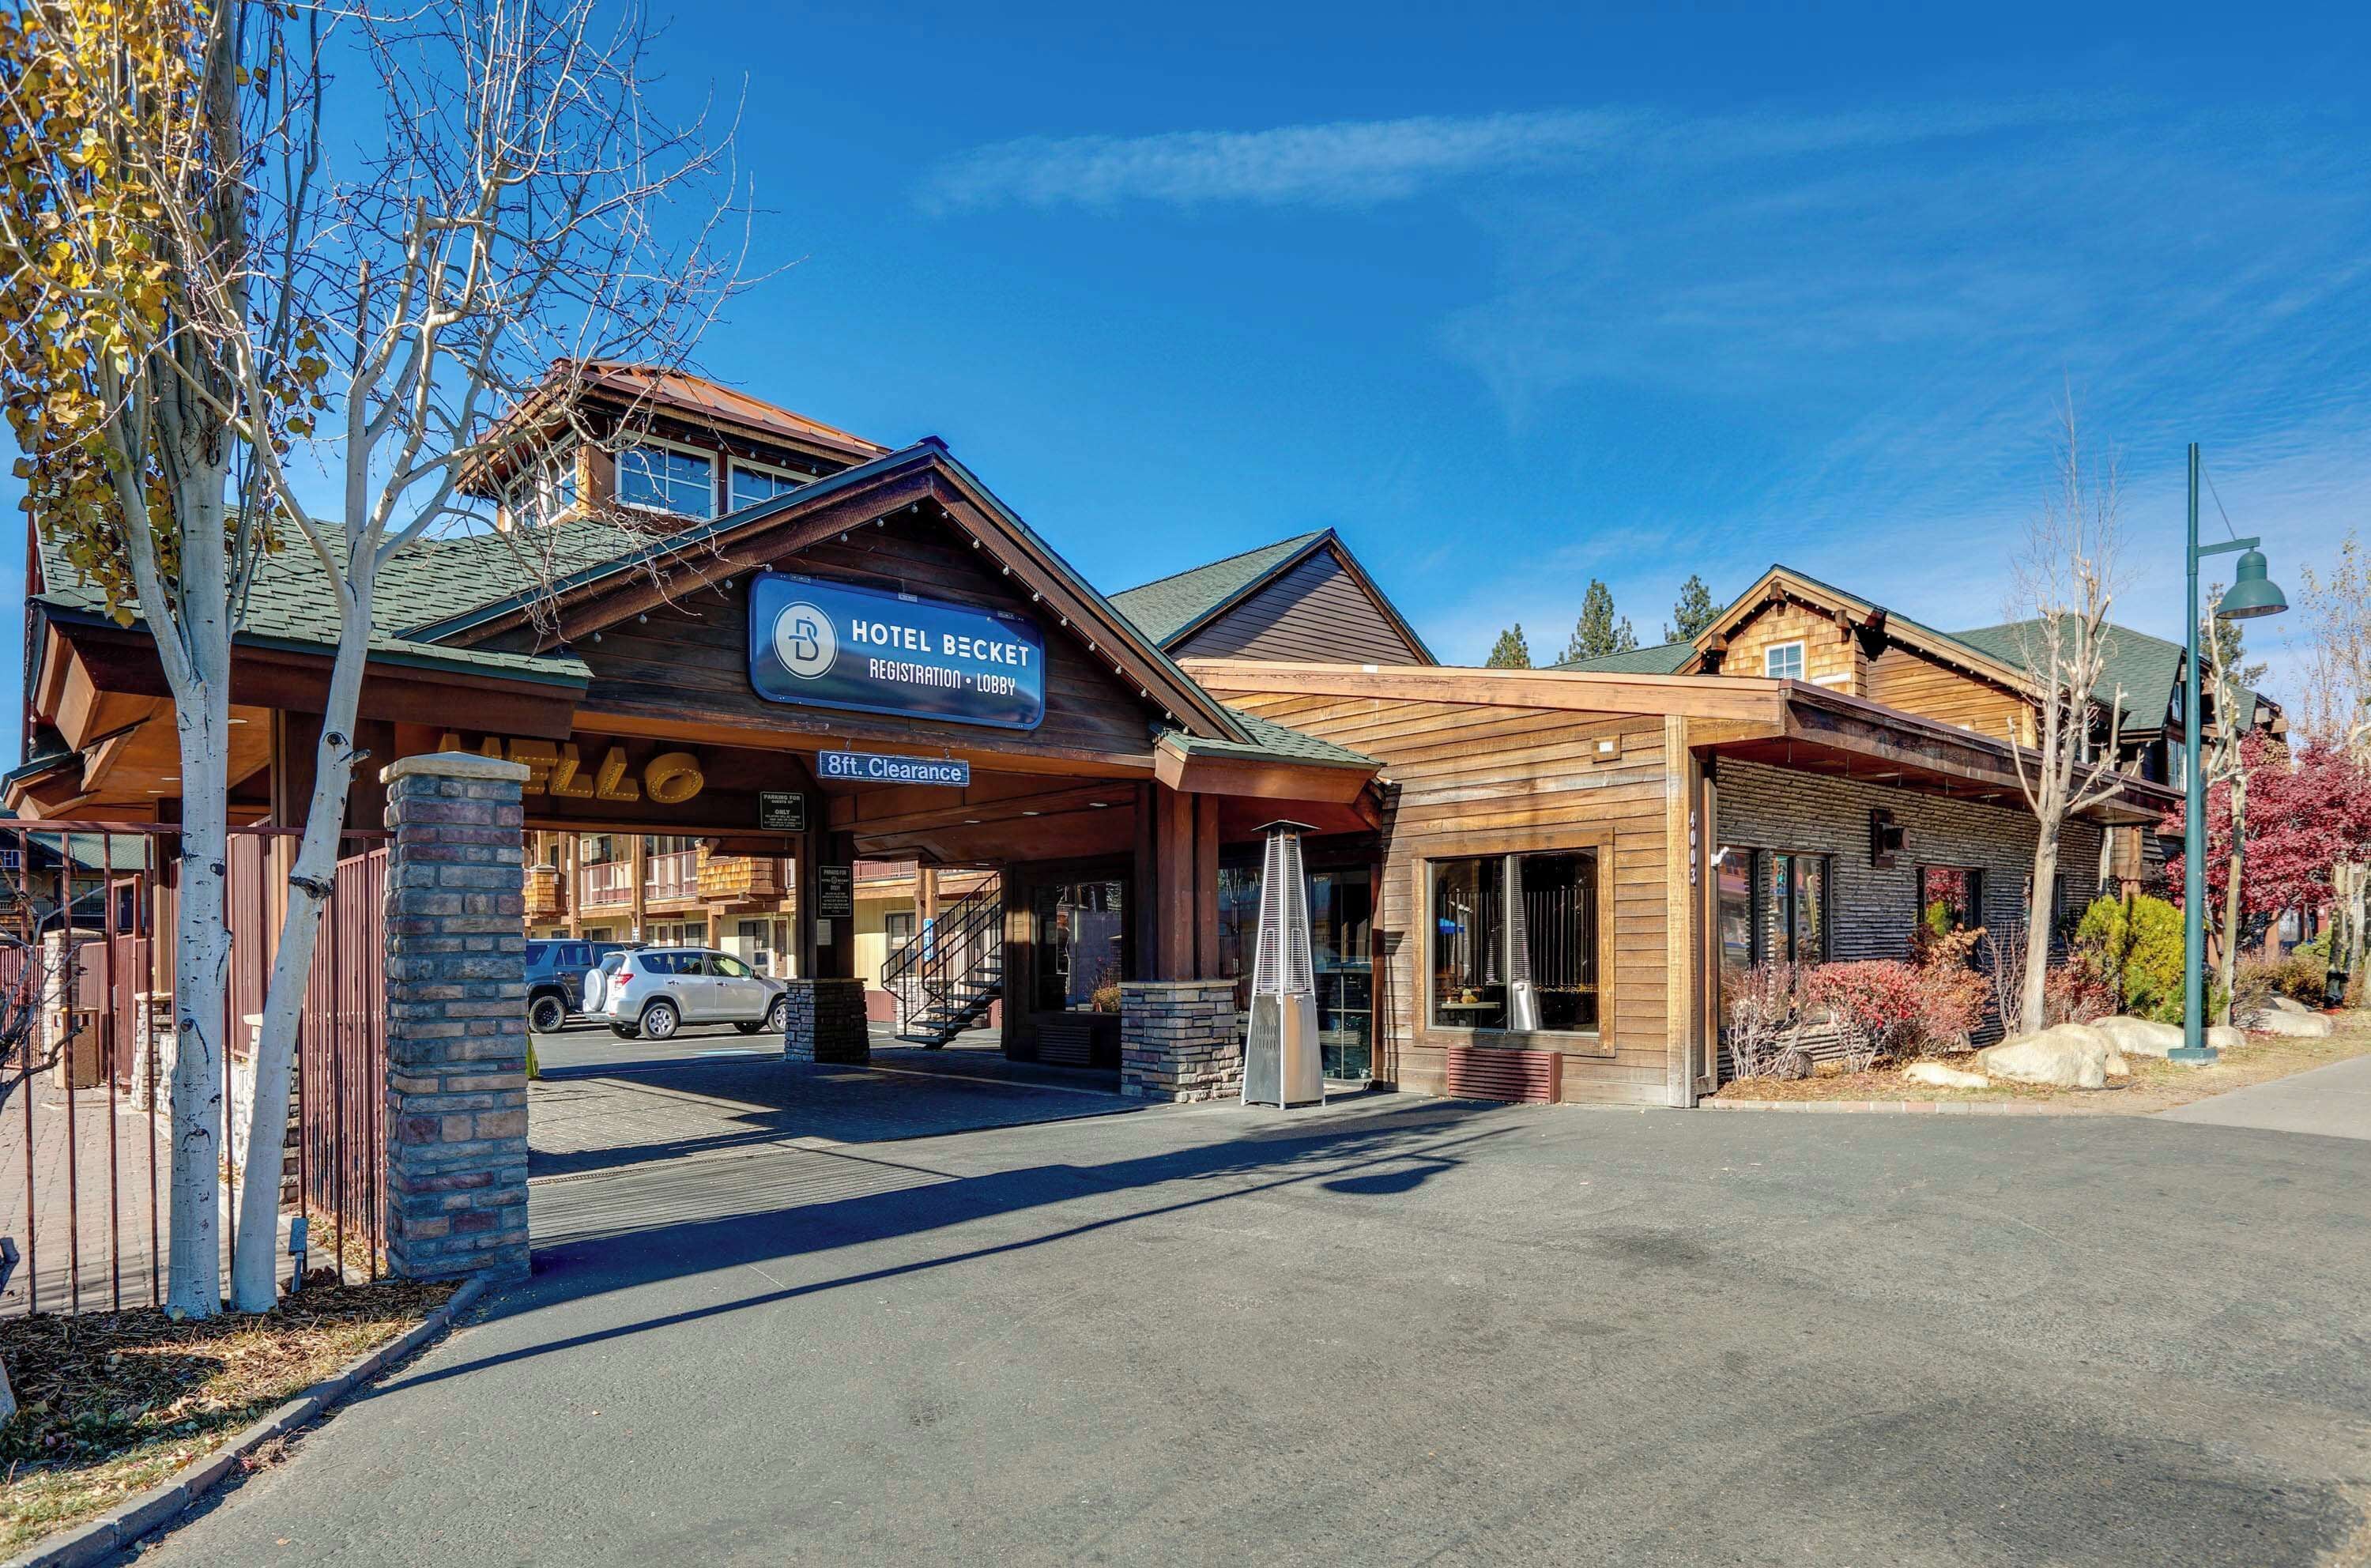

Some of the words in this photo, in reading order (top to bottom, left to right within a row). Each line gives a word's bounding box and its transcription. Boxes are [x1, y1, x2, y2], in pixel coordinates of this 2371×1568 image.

[852, 619, 931, 652] HOTEL
[943, 634, 1028, 666] BECKET
[869, 658, 961, 689] REGISTRATION
[977, 673, 1016, 696] LOBBY
[437, 733, 704, 804] ELLO
[828, 755, 862, 776] 8ft.
[869, 757, 962, 782] Clearance
